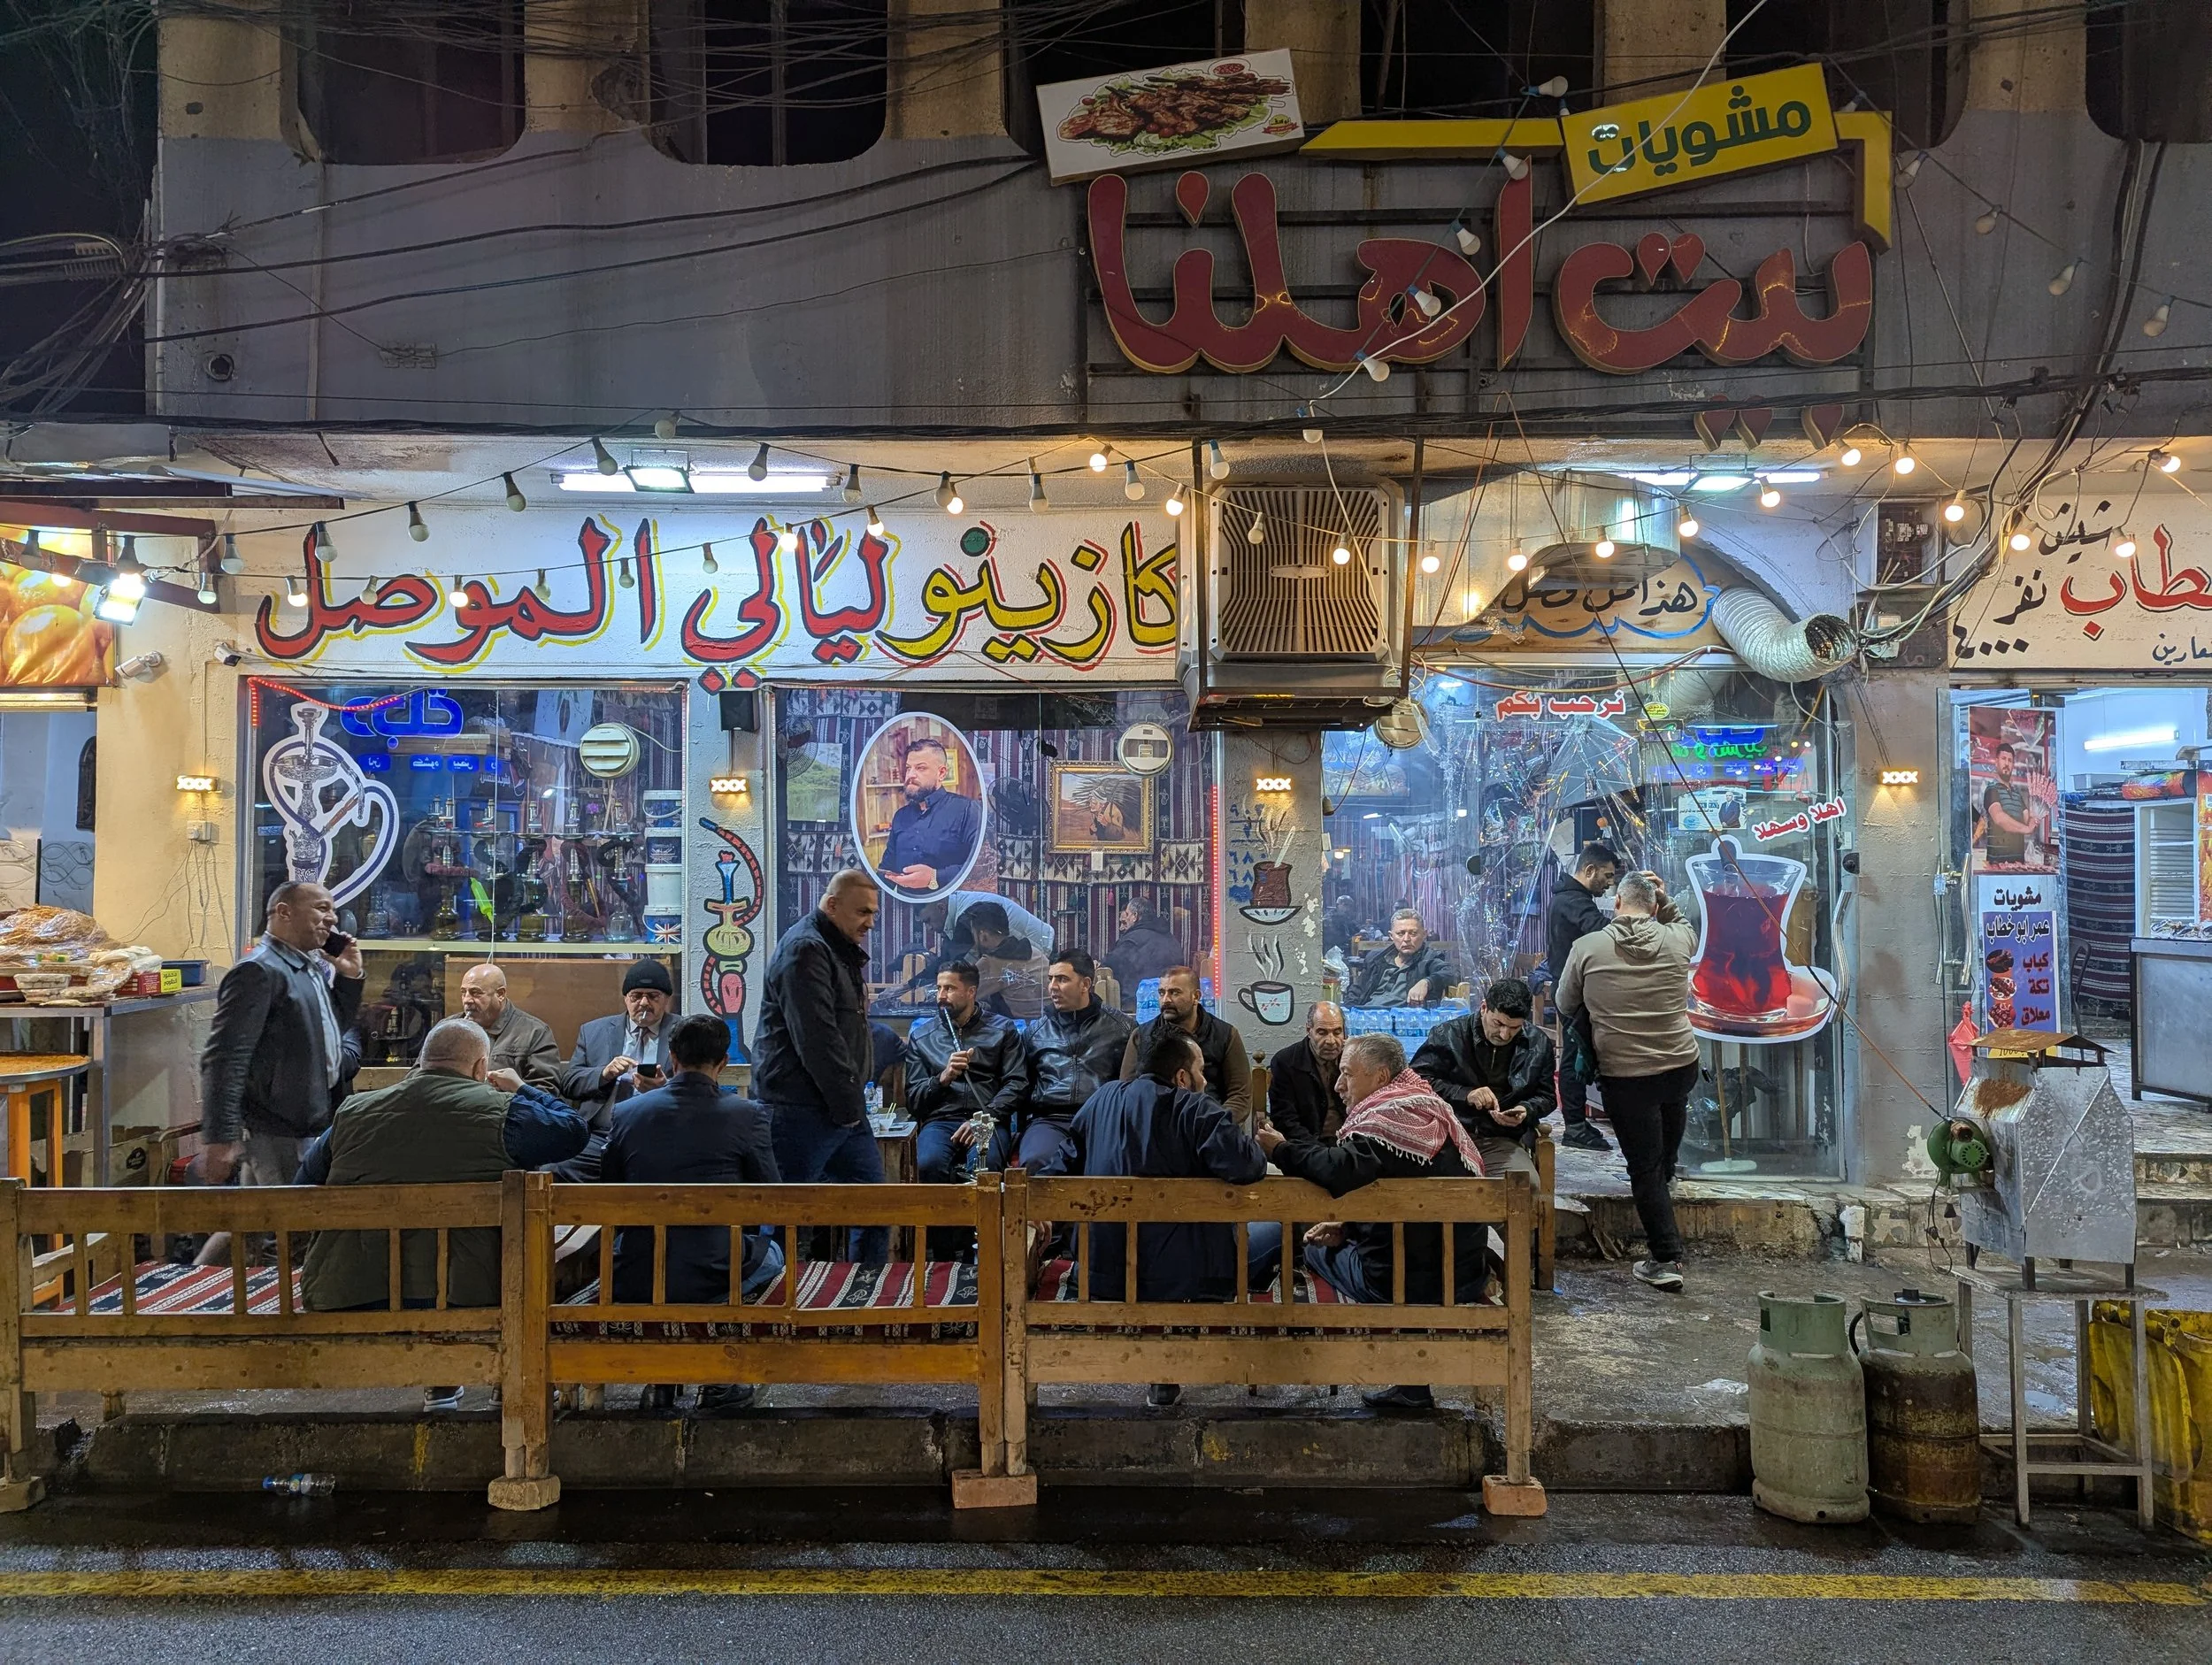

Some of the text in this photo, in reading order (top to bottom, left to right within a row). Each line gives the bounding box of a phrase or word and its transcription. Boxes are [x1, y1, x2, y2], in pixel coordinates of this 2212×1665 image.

[1587, 85, 1813, 175] مشويات
[1087, 156, 1874, 451] بيت اهلنا
[254, 513, 657, 665] الموصل
[876, 521, 1177, 664] كازينو
[1638, 578, 1698, 617] هذا
[2060, 522, 2212, 643] طاب
[1496, 690, 1541, 723] بكم
[1548, 689, 1626, 720] نرحب
[1754, 798, 1846, 840] اهلا وسهلا
[1993, 886, 2042, 911] مشويات
[1985, 913, 2050, 944] عمر ابو خطاب
[2023, 951, 2049, 973] كباب
[2027, 978, 2050, 996] تكة
[2021, 1007, 2050, 1027] معلاق
